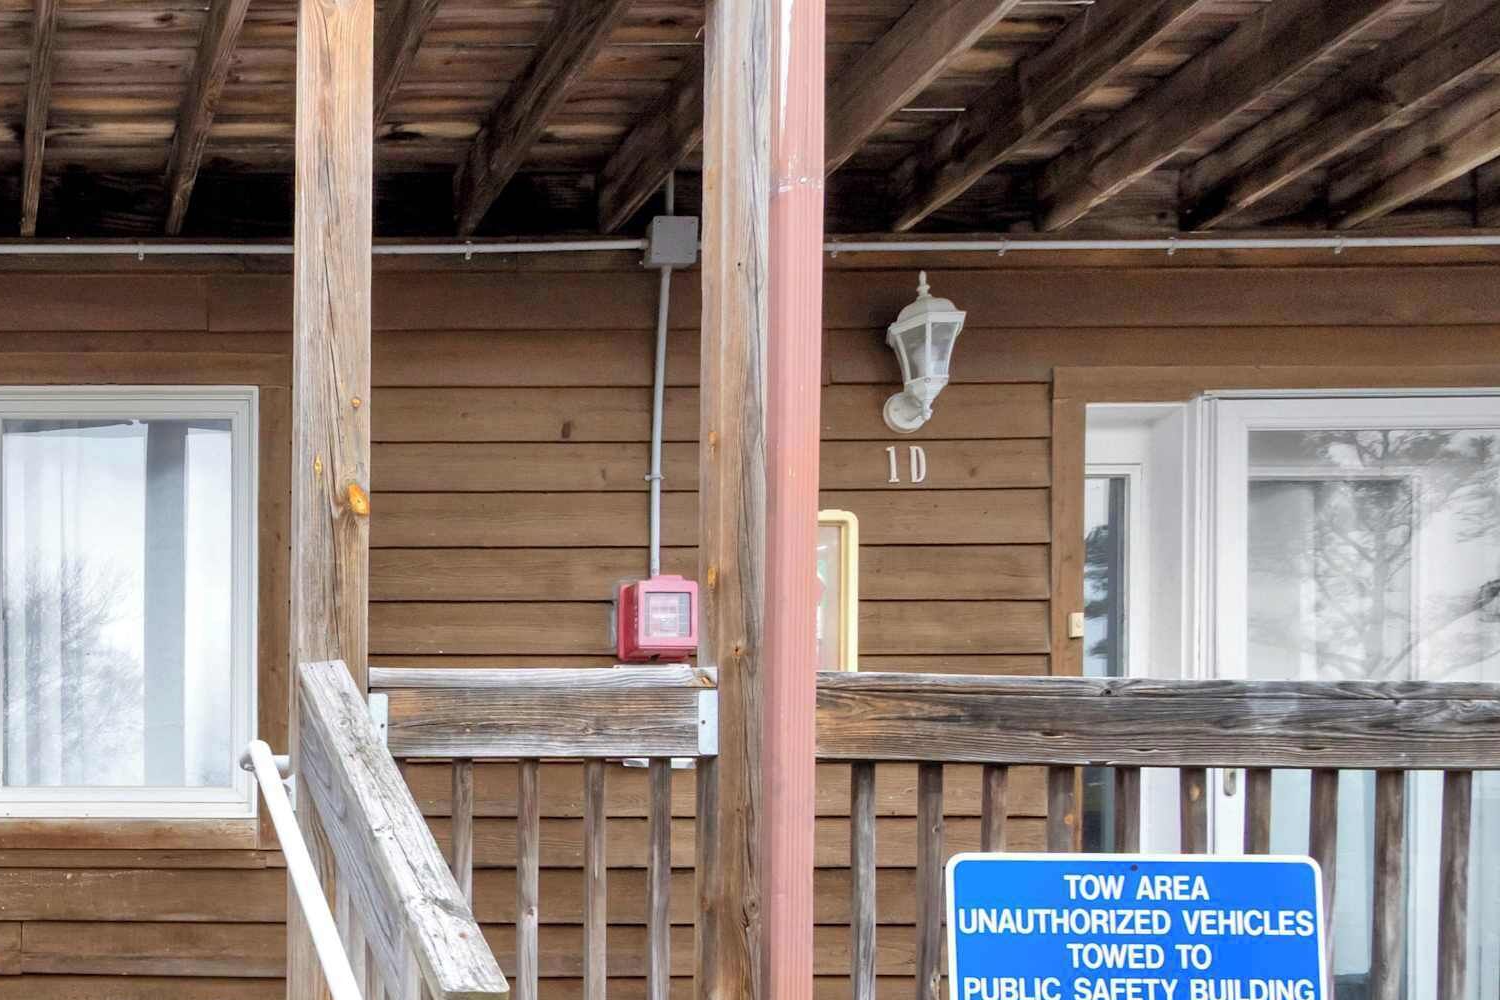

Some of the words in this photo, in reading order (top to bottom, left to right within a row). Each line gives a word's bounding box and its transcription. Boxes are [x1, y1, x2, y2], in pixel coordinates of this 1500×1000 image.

[1064, 874, 1125, 900] TOW
[1136, 875, 1210, 901] AREA
[958, 908, 1171, 935] UNAUTHORIZED
[1182, 910, 1314, 936] VEHICLES
[1066, 943, 1164, 969] TOWED
[1175, 944, 1212, 970] TO
